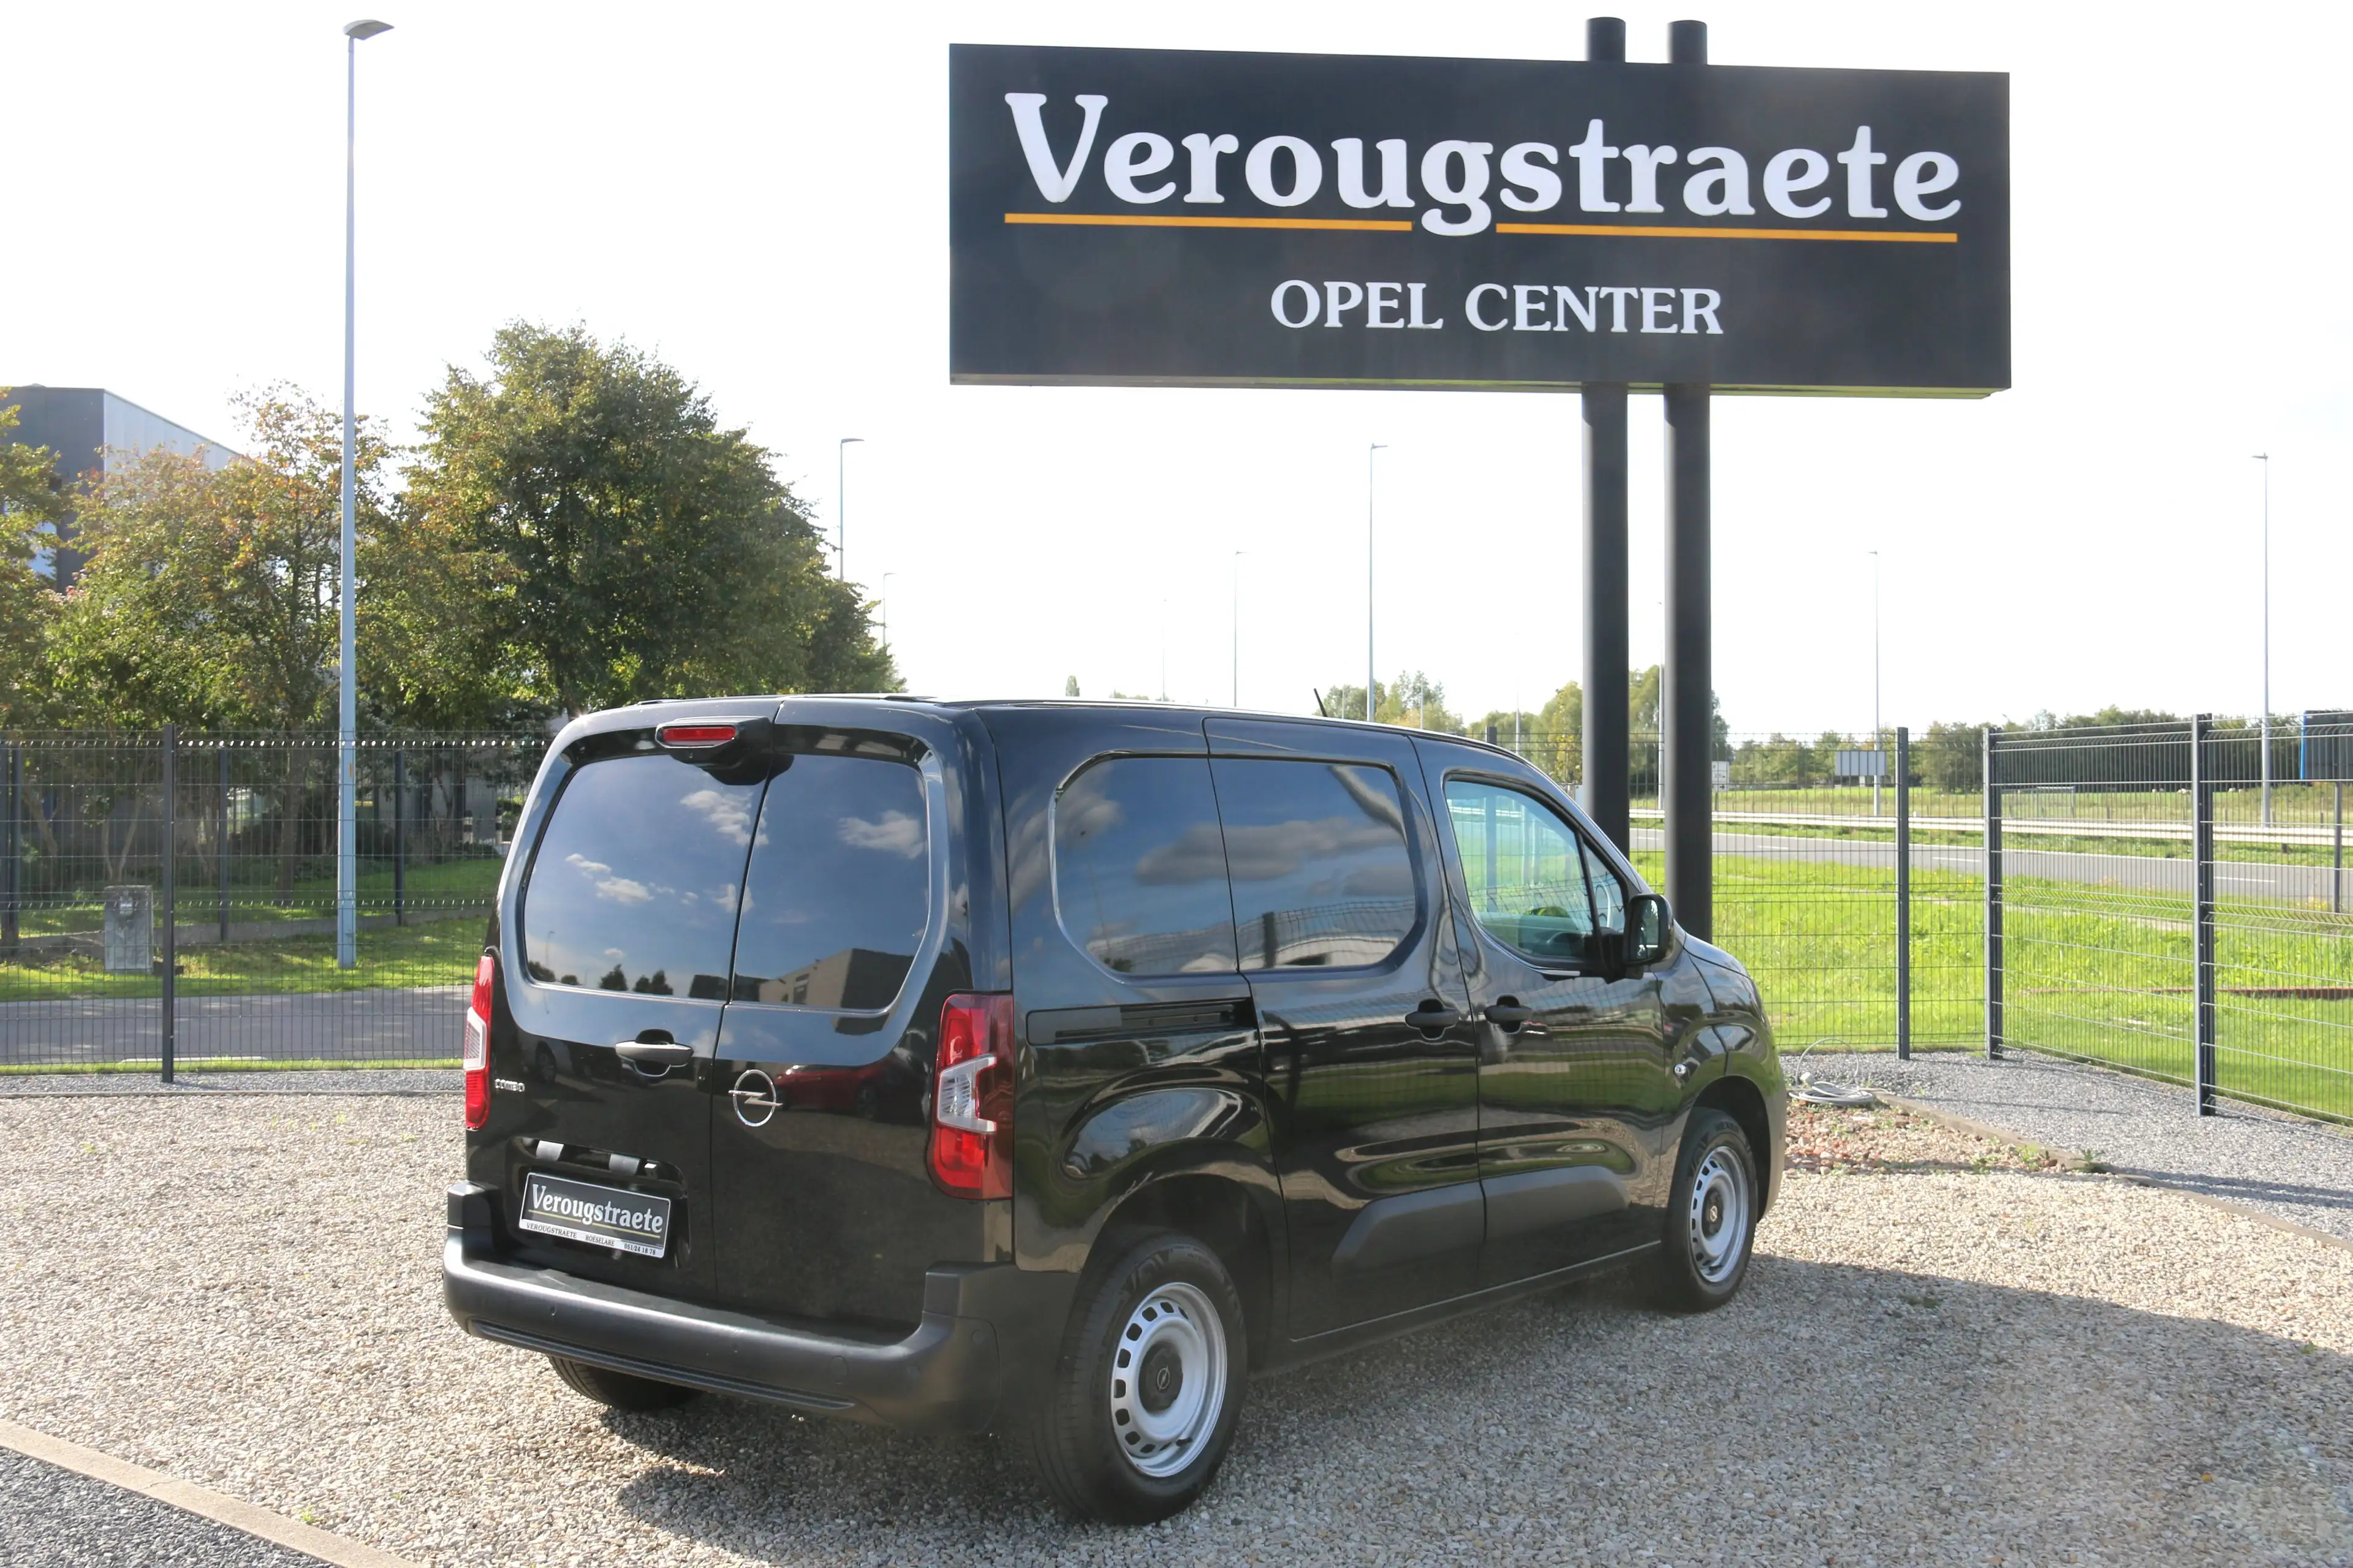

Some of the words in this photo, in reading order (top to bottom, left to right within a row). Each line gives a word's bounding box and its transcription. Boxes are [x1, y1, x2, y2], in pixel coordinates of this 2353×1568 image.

[1004, 93, 1961, 236] Verougstraete
[1271, 279, 1444, 329] OPEL
[1465, 283, 1724, 335] CENTER
[527, 1222, 577, 1238] VEROUGSTRAETE
[585, 1235, 615, 1246] ROESELARE
[532, 1183, 663, 1233] Verougstraete
